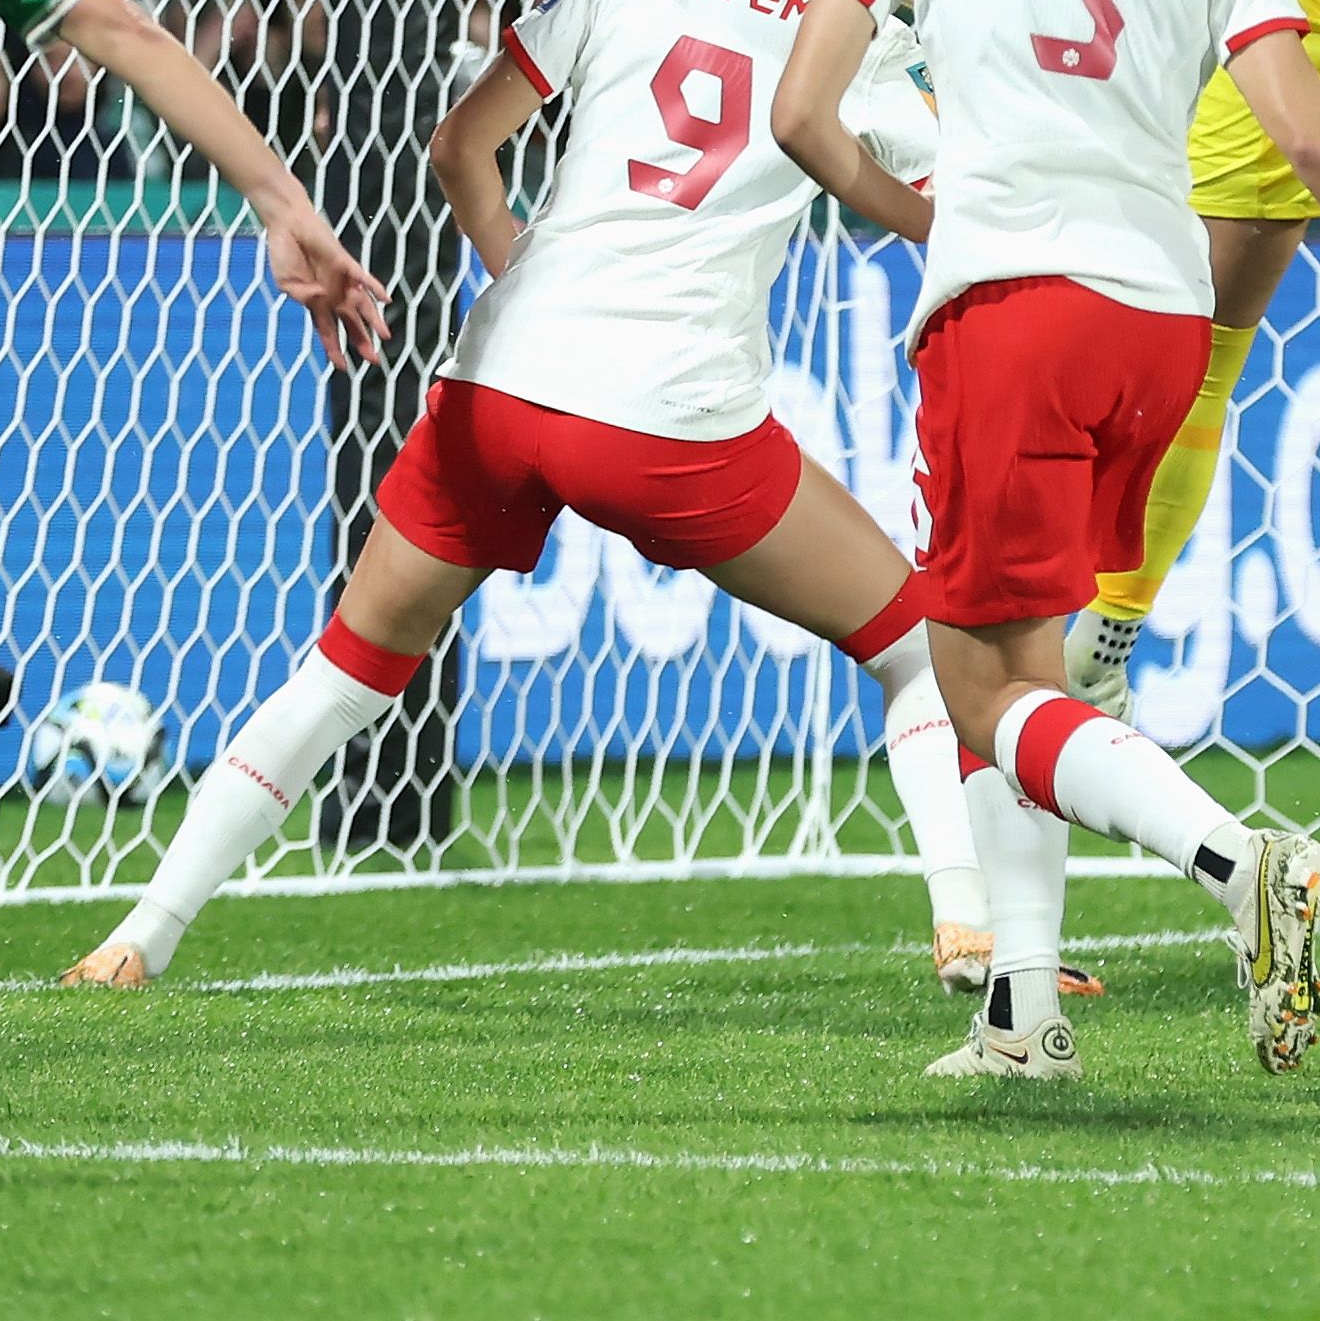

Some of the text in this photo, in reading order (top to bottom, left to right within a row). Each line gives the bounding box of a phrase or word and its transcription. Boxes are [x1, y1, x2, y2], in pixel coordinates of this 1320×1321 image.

[627, 33, 753, 211] 9
[889, 719, 951, 750] CANAD
[228, 756, 290, 810] CANADA
